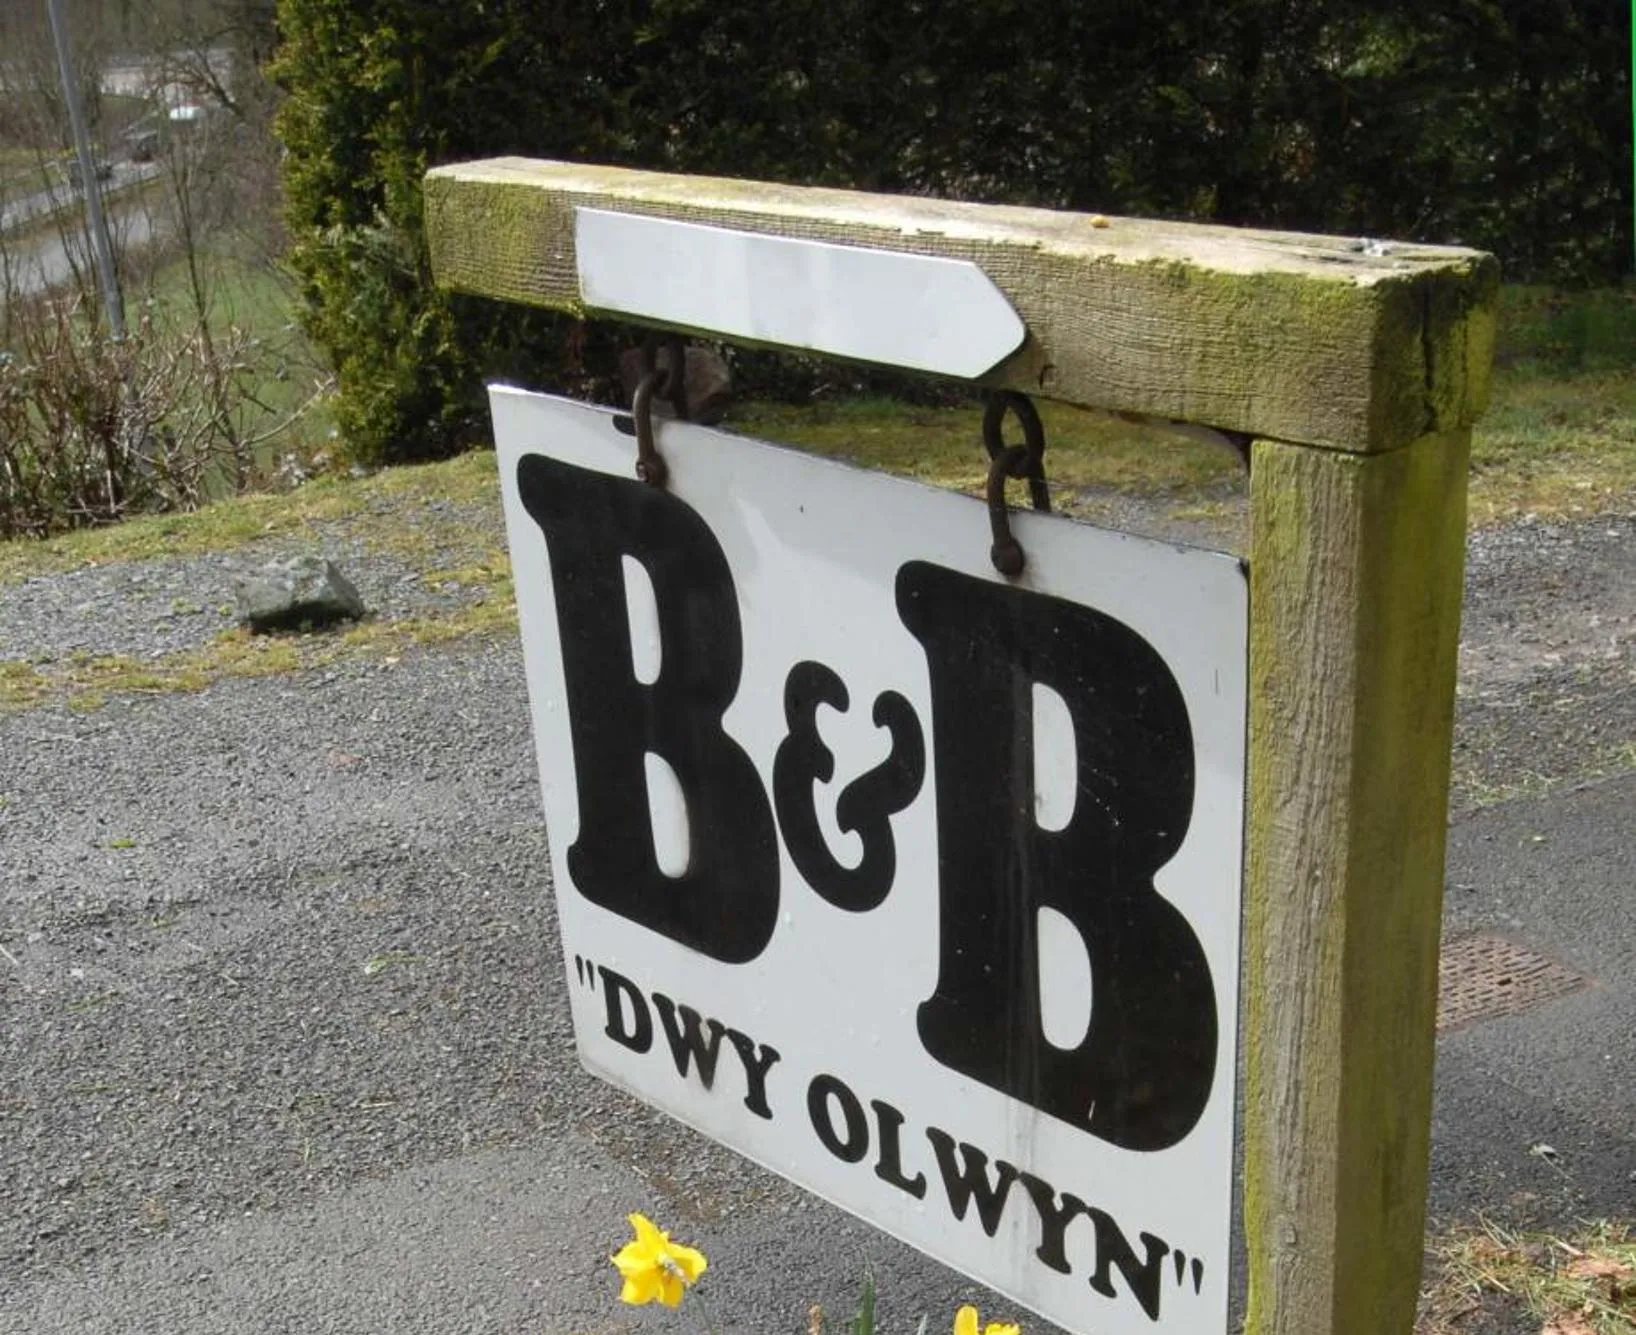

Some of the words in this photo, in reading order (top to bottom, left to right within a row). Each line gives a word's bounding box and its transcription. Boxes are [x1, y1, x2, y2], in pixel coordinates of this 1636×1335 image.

[517, 454, 1218, 1153] B&B
[576, 955, 781, 1120] "DWY
[807, 1074, 1204, 1321] OLWYN"
